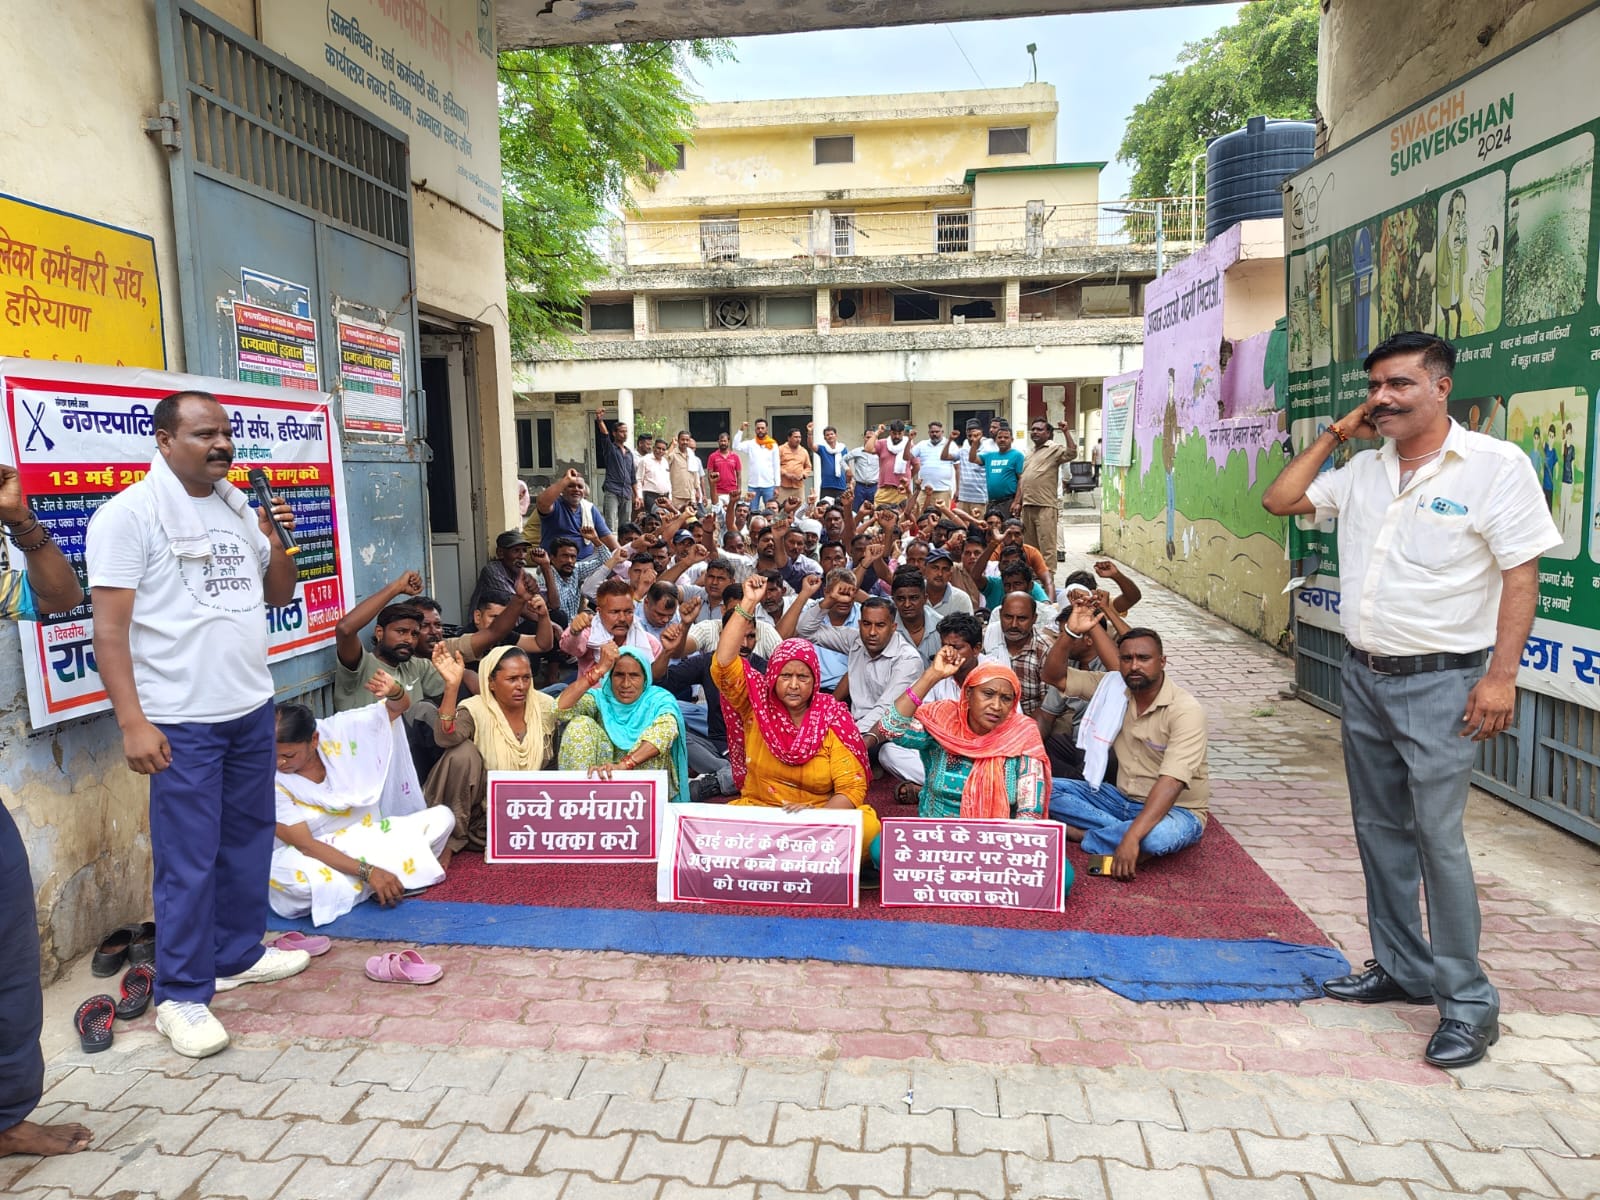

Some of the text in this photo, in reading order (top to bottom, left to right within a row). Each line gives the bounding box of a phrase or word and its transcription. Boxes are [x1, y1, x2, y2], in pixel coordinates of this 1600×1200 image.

[325, 43, 364, 88] कार्यालय
[1391, 90, 1465, 151] SWACHH
[1391, 92, 1514, 176] SURVEKSHAN
[1478, 124, 1511, 161] 2024
[41, 244, 109, 296] कर्मचारी
[113, 261, 147, 308] संघ,
[5, 285, 92, 332] हरियाणा
[61, 404, 155, 436] नगरपालि
[247, 414, 274, 440] संघ,
[277, 416, 322, 441] हरियाणा
[48, 471, 79, 486] 13
[85, 466, 114, 487] मई
[277, 469, 298, 484] लागू
[299, 466, 319, 480] करो
[1561, 571, 1574, 588] और
[1542, 594, 1551, 613] दूर
[48, 632, 52, 642] 3
[506, 791, 647, 820] कच्चे कर्मचारी
[509, 825, 639, 850] को पक्का करो
[695, 831, 836, 853] हाई कोर्ट के फैसले के
[894, 825, 1048, 851] 2 वर्ष के अनुभव
[687, 852, 842, 875] अनुसार कच्चे कर्मचारी
[895, 845, 1049, 868] के आधार पर सभी
[713, 874, 813, 894] को पक्का करो
[893, 865, 1045, 888] सफाई कर्मचारियों
[913, 884, 934, 902] को
[938, 889, 981, 903] पक्का
